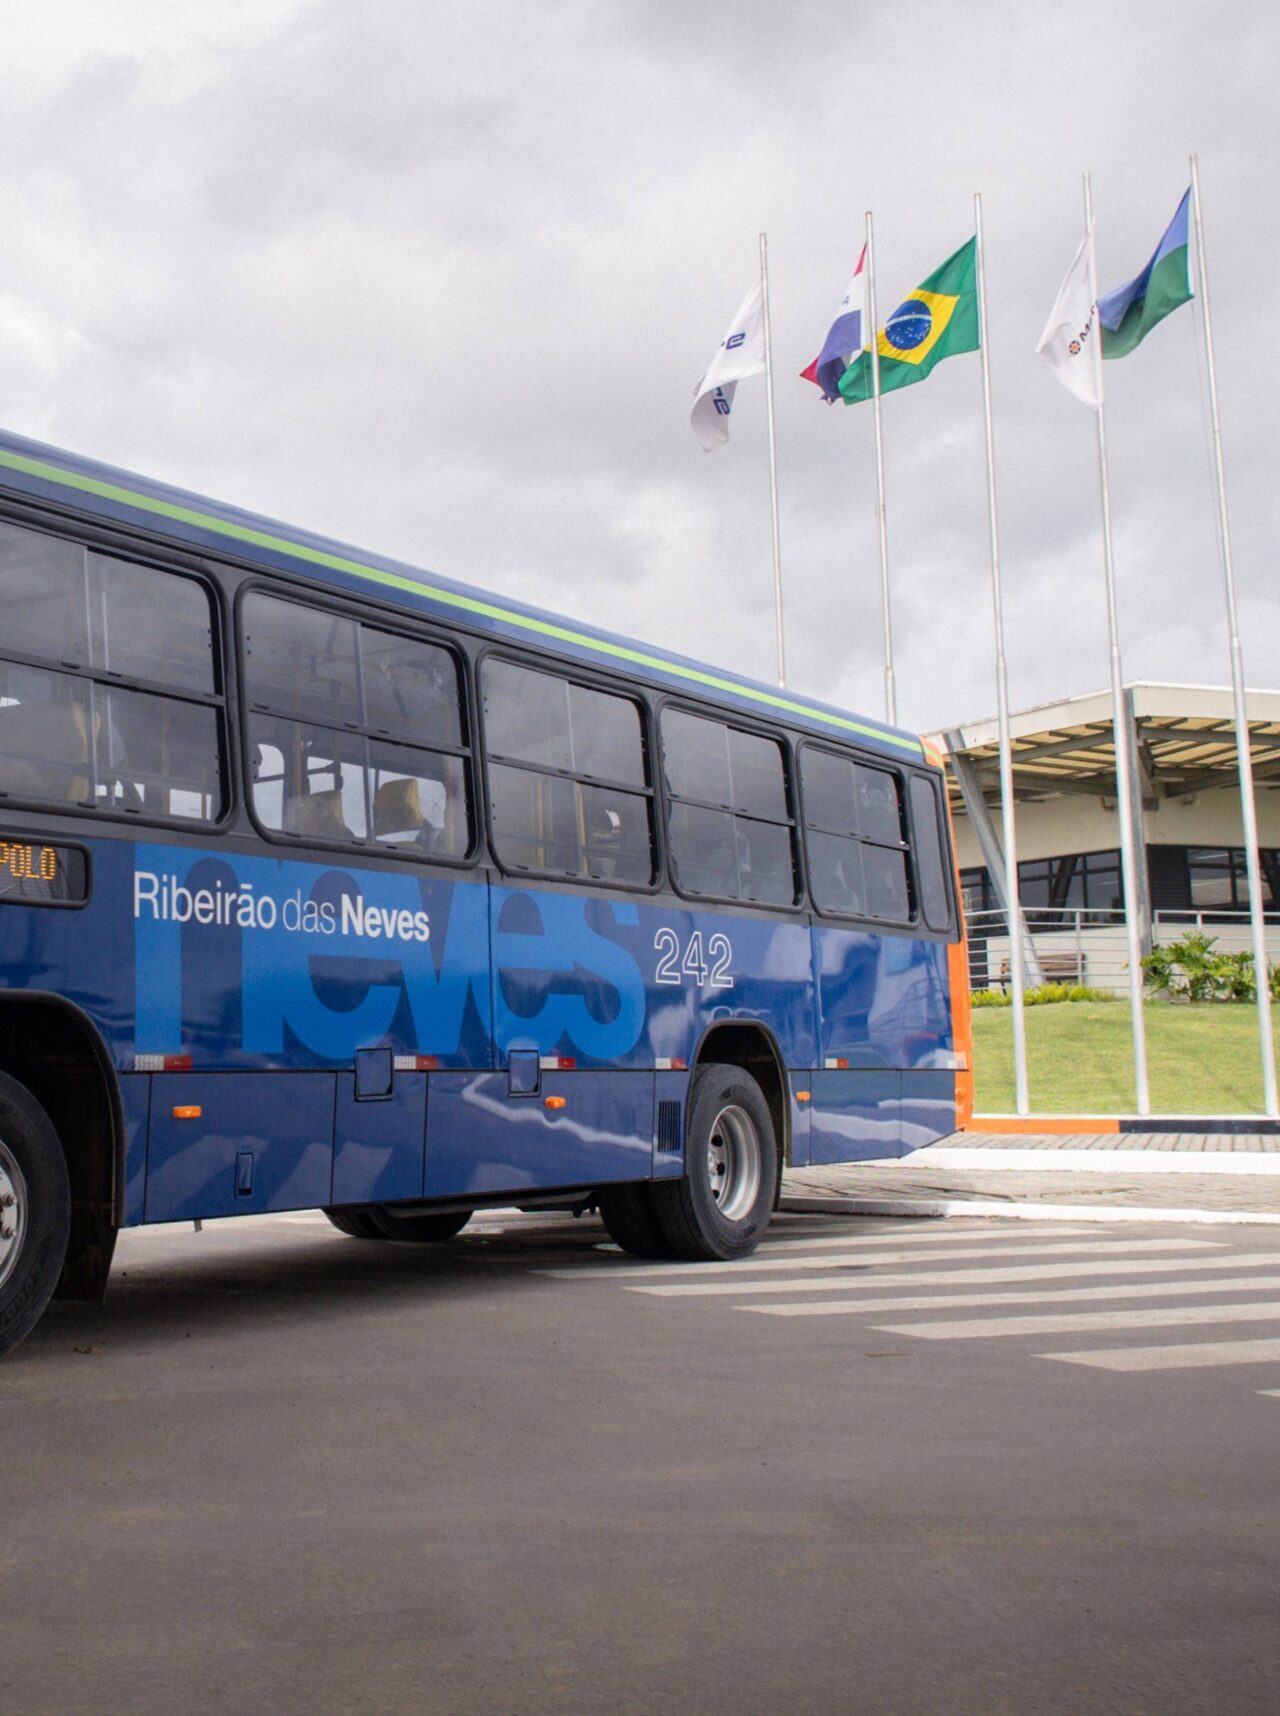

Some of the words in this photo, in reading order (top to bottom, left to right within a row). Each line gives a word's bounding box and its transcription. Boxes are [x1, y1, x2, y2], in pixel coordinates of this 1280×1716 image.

[134, 871, 276, 929] Ribeirão
[283, 888, 335, 934] das
[341, 893, 430, 942] Neves
[654, 927, 734, 988] 242
